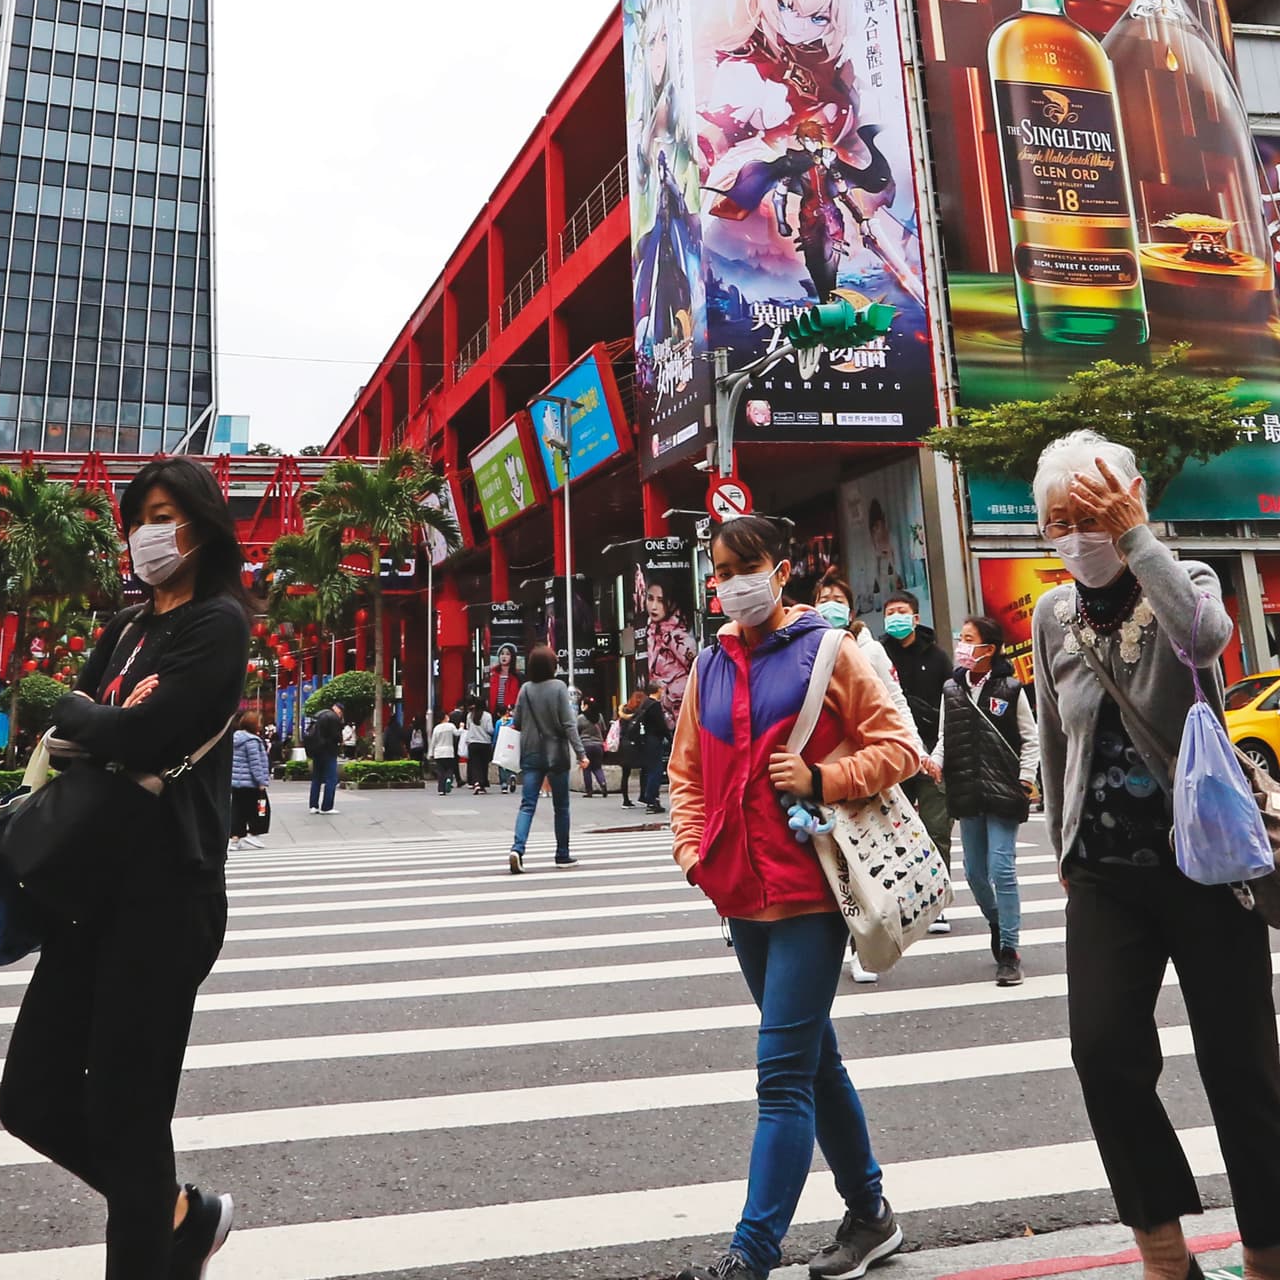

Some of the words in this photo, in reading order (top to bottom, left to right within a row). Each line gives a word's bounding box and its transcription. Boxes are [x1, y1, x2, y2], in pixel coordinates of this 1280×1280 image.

[1044, 52, 1058, 65] 18
[1006, 125, 1022, 136] THE
[1017, 146, 1041, 164] Single
[1040, 149, 1063, 164] Malt
[1088, 152, 1115, 170] Whisky
[1033, 165, 1067, 178] GLEN
[1071, 169, 1099, 180] ORD
[1056, 189, 1079, 211] 18
[1034, 260, 1053, 268] RICH,
[1055, 262, 1079, 270] SWEET
[645, 541, 666, 550] ONE
[667, 540, 685, 550] BOY
[492, 604, 507, 612] ONE
[576, 649, 591, 658] BOY
